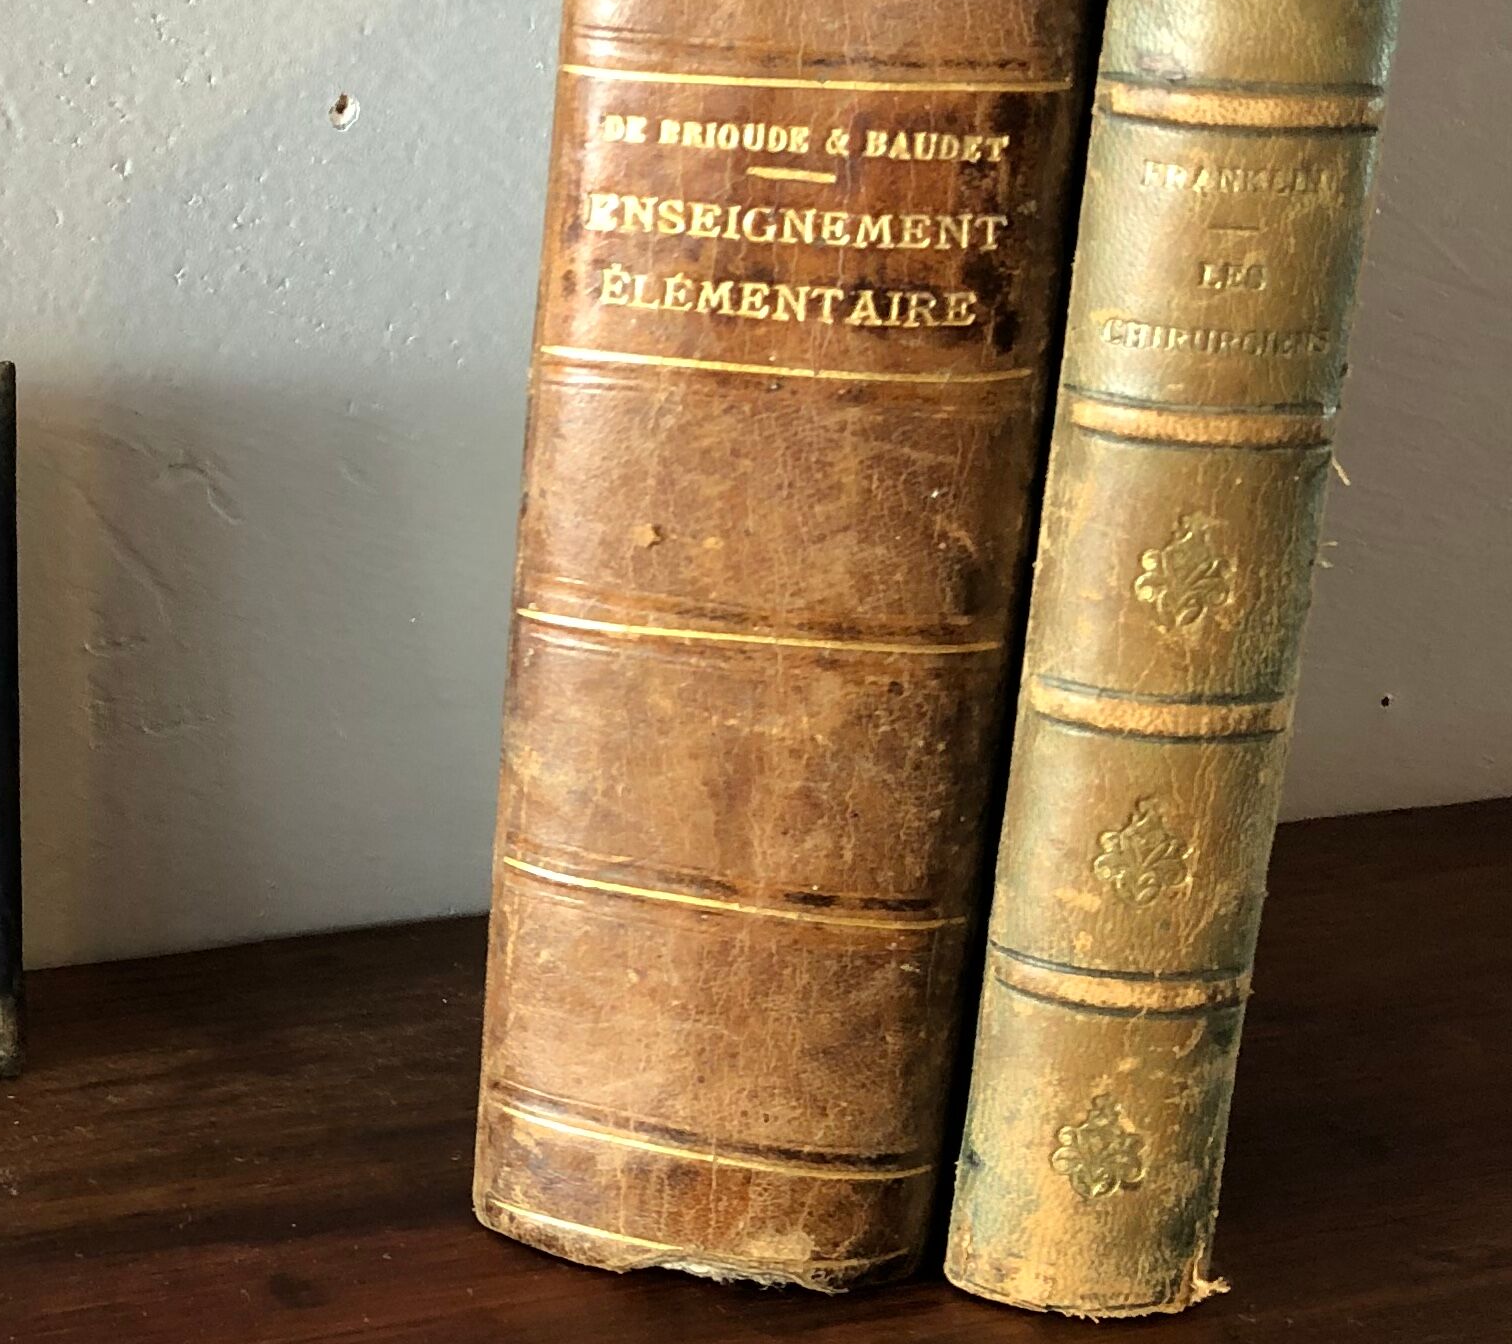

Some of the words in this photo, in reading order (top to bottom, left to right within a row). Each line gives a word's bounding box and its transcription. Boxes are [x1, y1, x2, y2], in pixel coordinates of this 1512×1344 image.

[602, 113, 648, 144] DE
[658, 118, 810, 154] BRIOUDE
[824, 130, 851, 157] &
[863, 129, 1011, 163] BAUDET
[584, 192, 1009, 252] ENSEIGNEMENT
[599, 262, 979, 329] ÉLÉMENTAIRE
